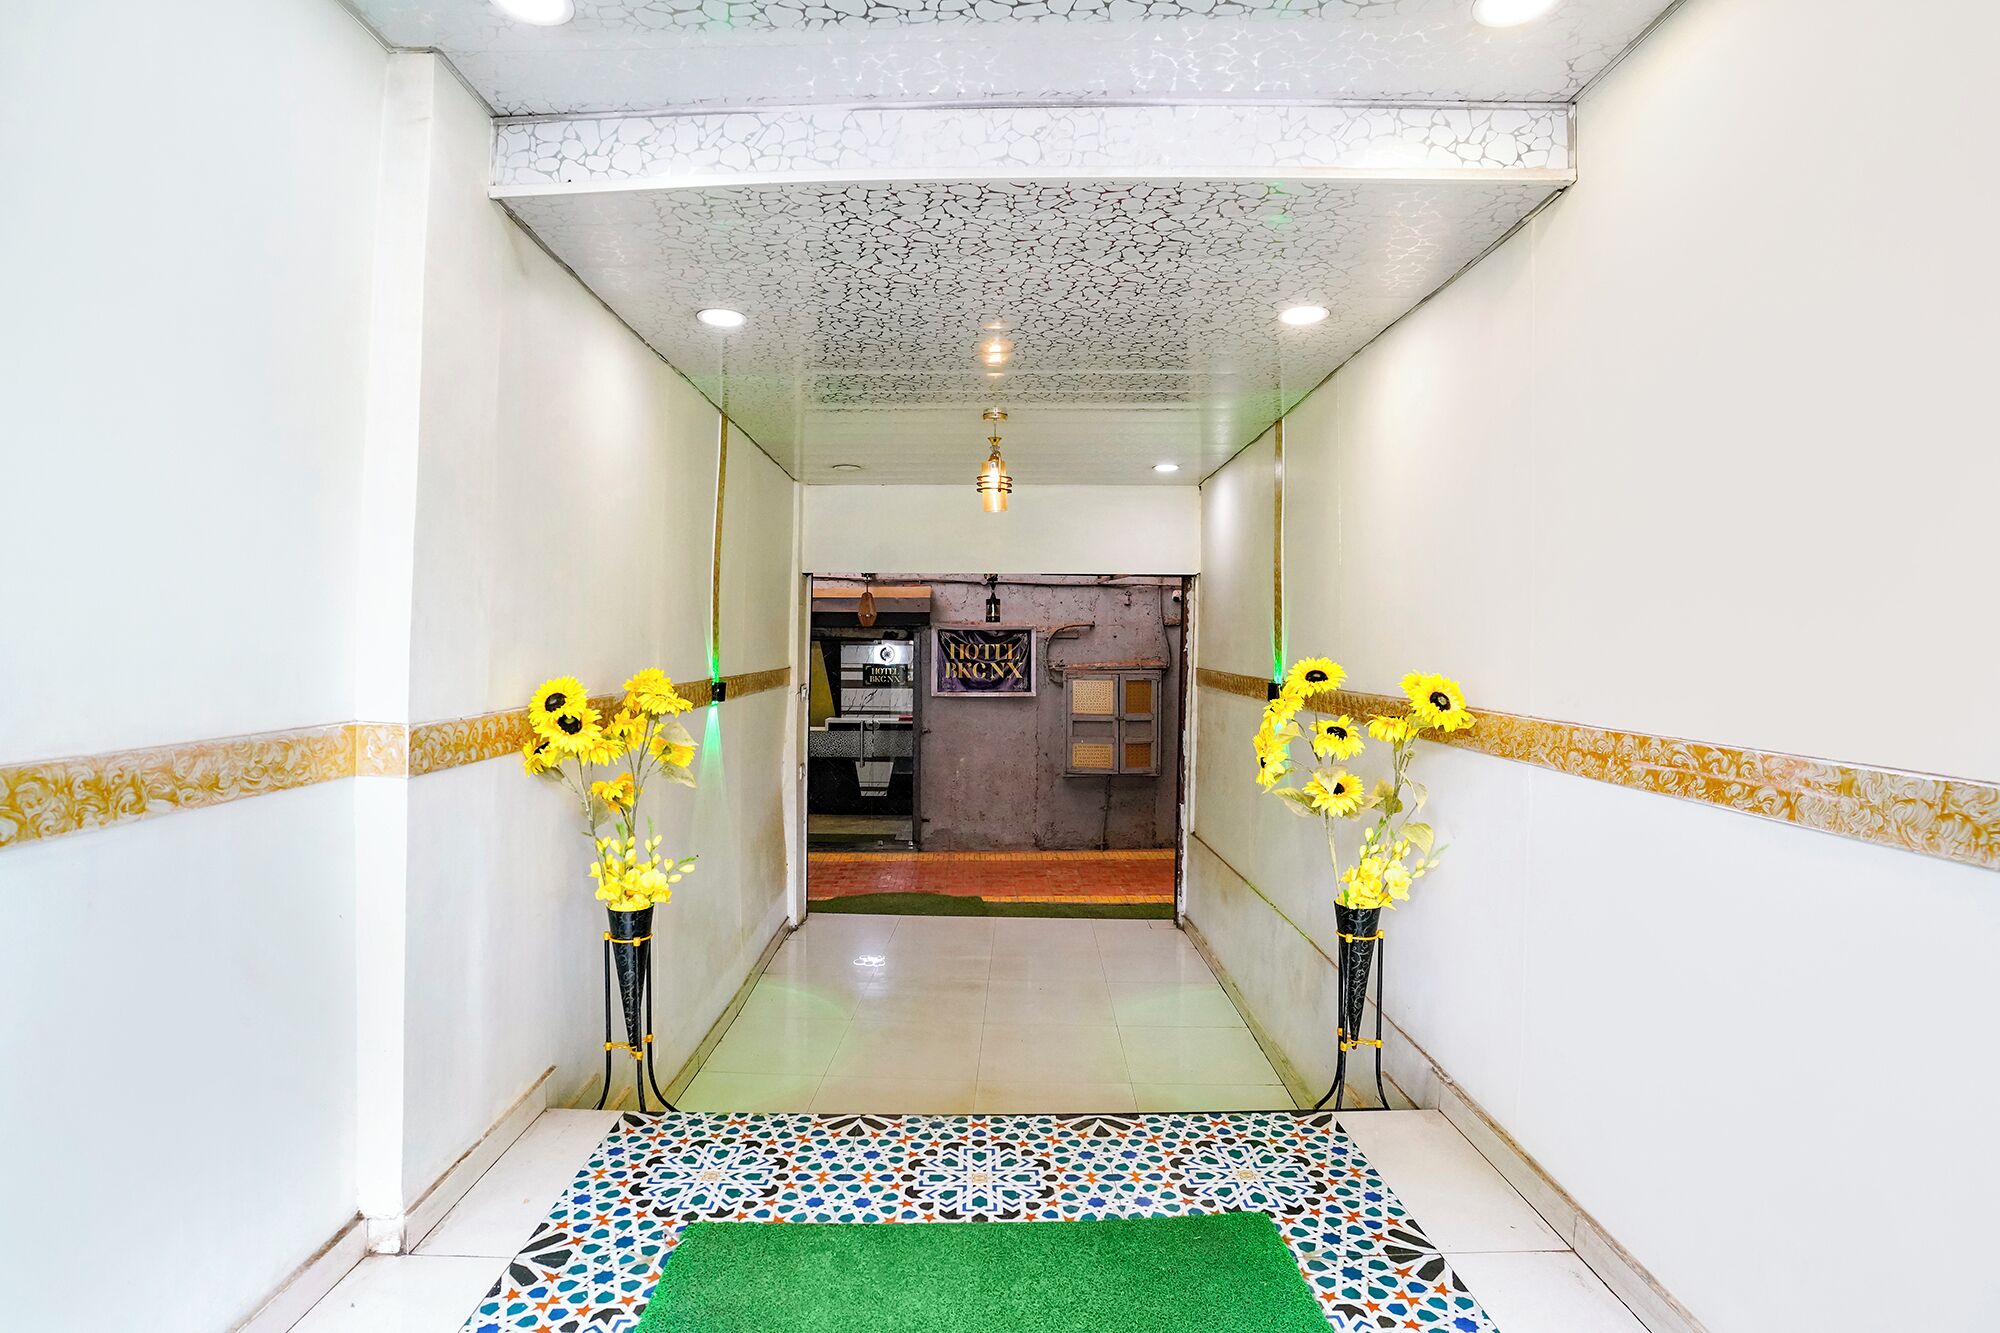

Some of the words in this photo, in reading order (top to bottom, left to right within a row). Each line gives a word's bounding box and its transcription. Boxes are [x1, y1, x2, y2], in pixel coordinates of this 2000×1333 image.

[950, 643, 1020, 660] HOTEL
[871, 667, 900, 675] HOTEL
[945, 662, 986, 679] BKC
[990, 662, 1023, 679] NX
